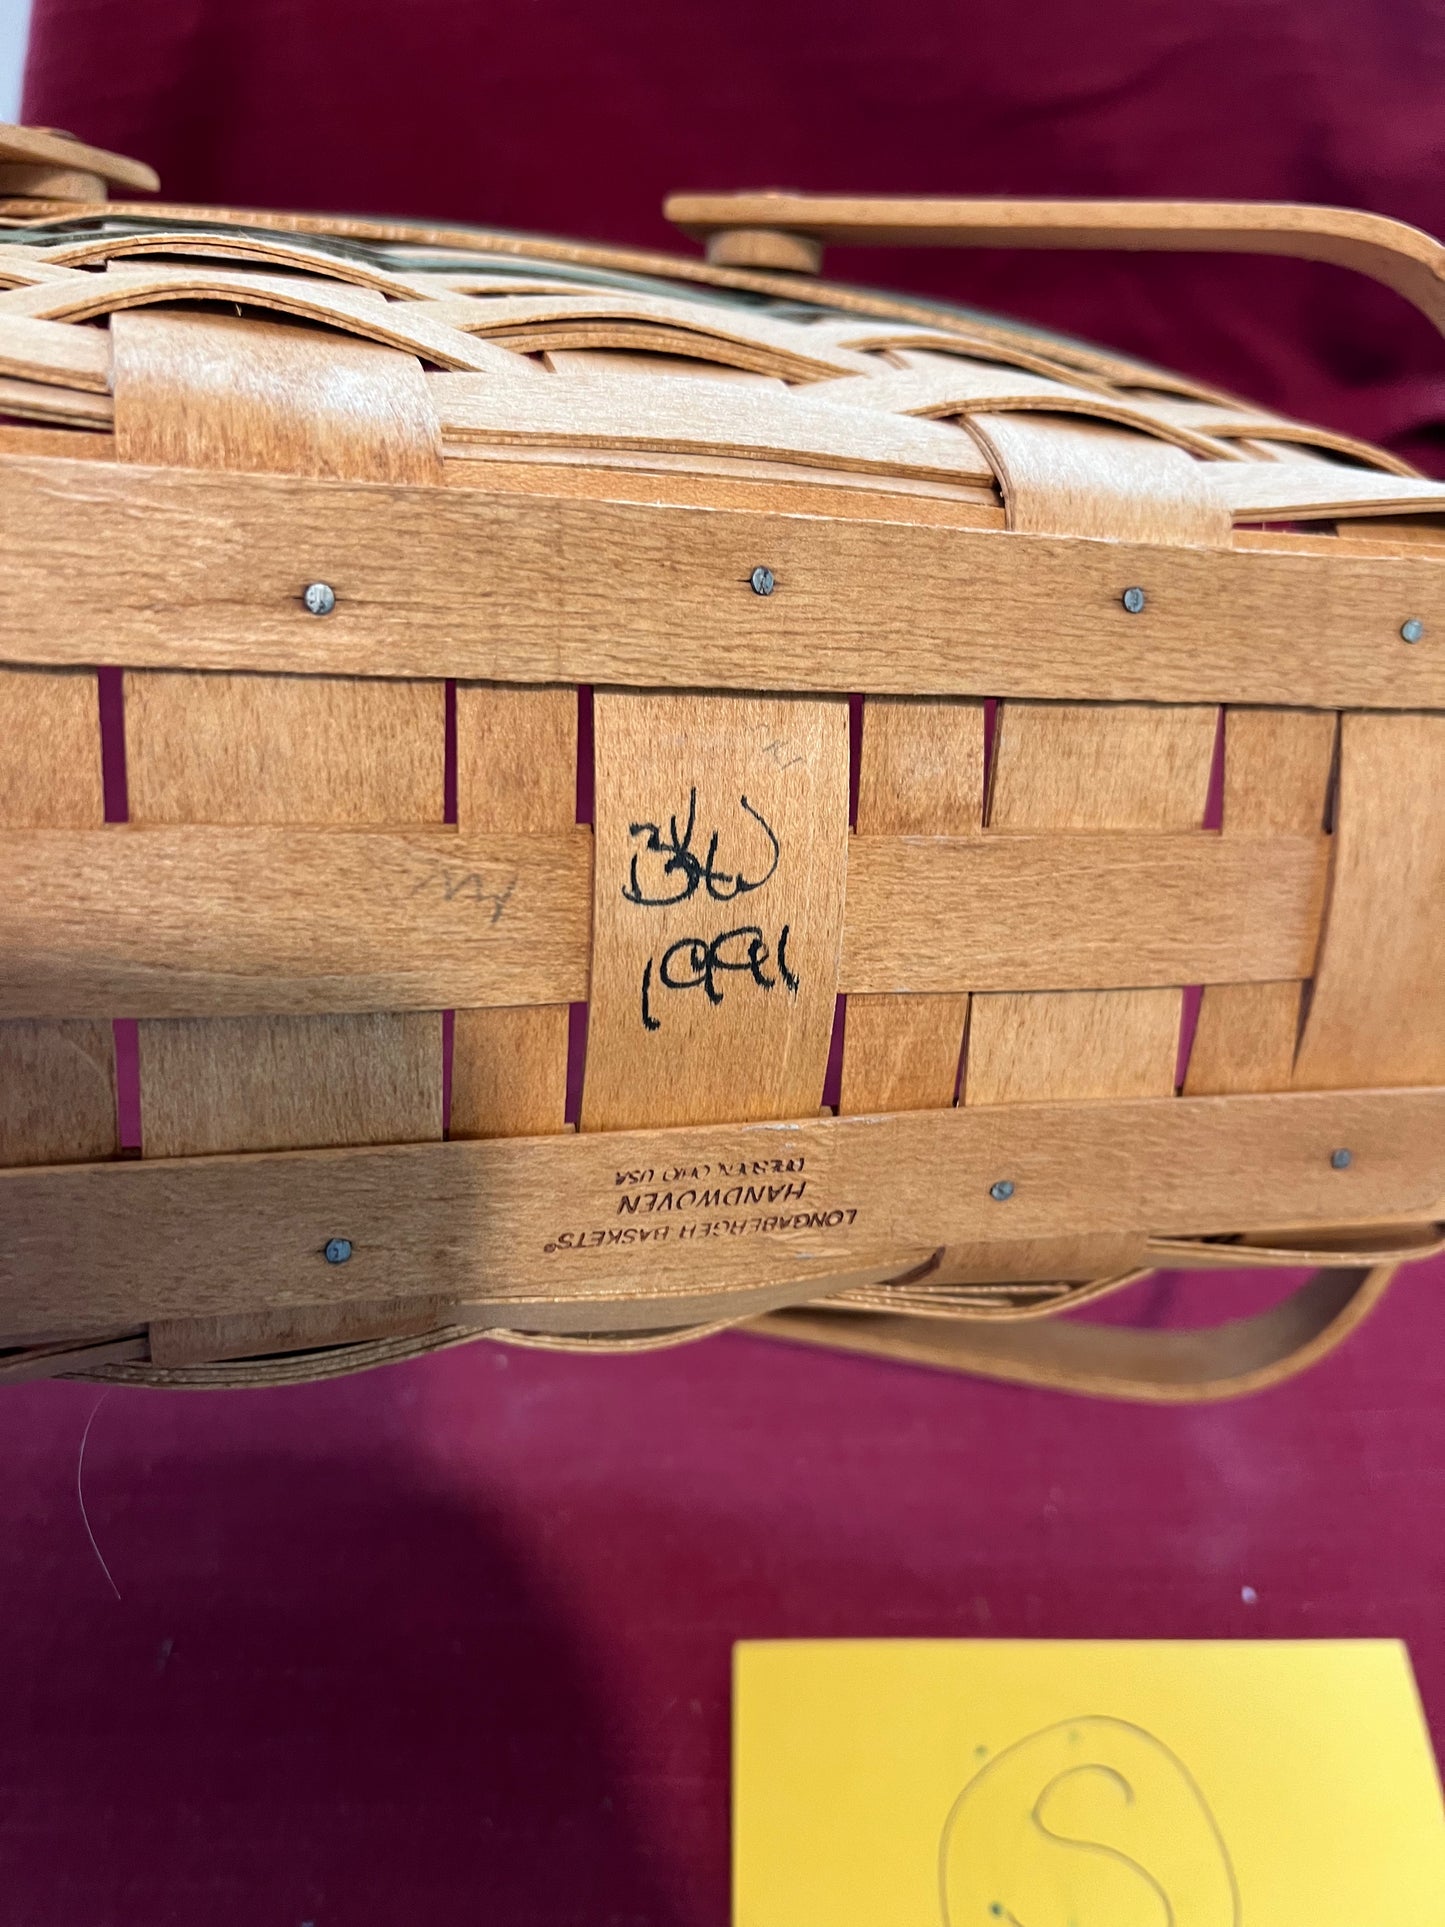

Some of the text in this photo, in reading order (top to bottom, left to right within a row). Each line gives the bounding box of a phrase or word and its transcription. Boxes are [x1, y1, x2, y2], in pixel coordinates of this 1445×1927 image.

[641, 924, 800, 1032] 1991
[614, 1168, 655, 1186] USA
[616, 1181, 808, 1214] HANDWOVEN
[679, 1209, 858, 1240] LONGABERGER
